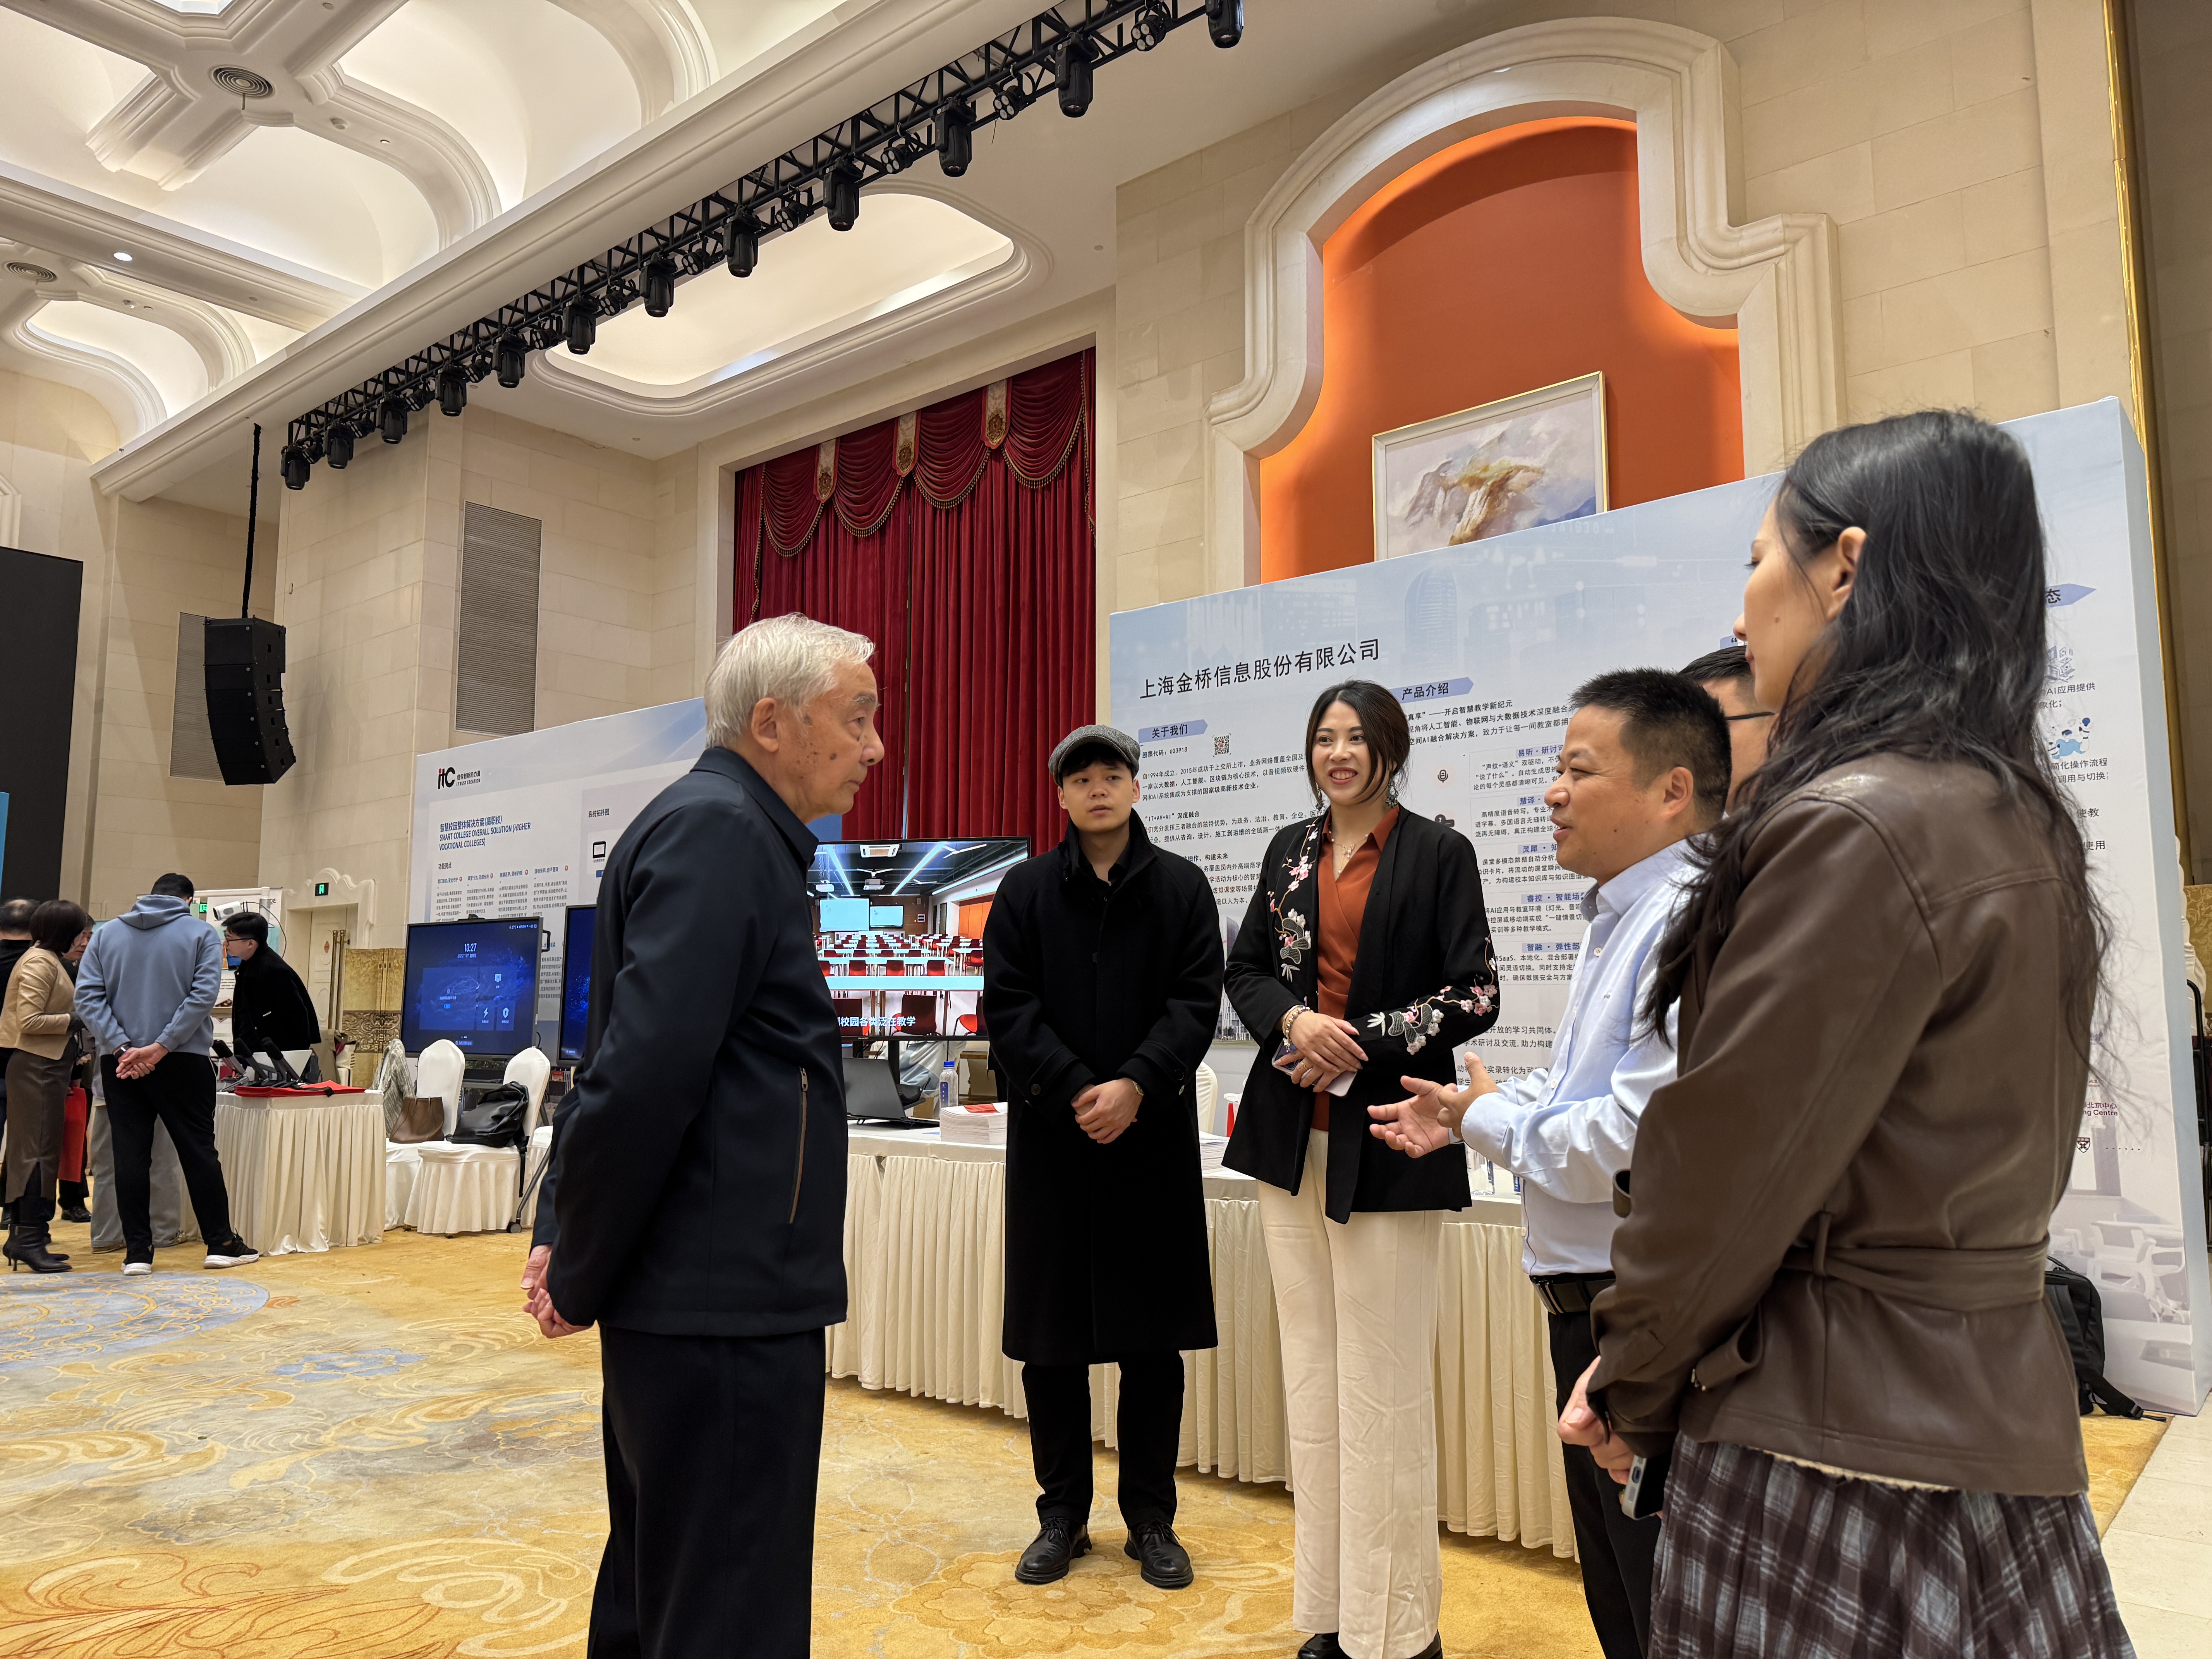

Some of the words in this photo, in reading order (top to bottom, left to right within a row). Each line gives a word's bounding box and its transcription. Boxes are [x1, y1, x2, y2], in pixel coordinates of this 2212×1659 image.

[1140, 638, 1379, 699] 上海金桥信息股份有限公司
[1402, 682, 1449, 701] 产品介绍
[2047, 682, 2095, 695] AI应用提供
[1152, 723, 1188, 739] 关于我们
[1410, 717, 1573, 746] 空间AI融合解决方案，致力于让每一间教室都拥
[1142, 747, 1188, 758] 股票代码：603918
[1142, 765, 1307, 790] 一家以大数据、人工智能、区块链为核心技术，以音视频软硬件
[1145, 810, 1322, 833] 们充分发挥三者融合的独特优势，为政务、法治、教育、企业、医
[440, 833, 452, 841] SMART
[453, 830, 471, 839] COLLEGE
[472, 828, 489, 837] OVERALL
[490, 825, 512, 835] SOLUTION
[513, 822, 531, 833] (HIGHER
[1149, 825, 1286, 843] 行业，提供从咨询、设计、施工到运维的全链路一体
[439, 841, 463, 850] VOCATIONAL
[464, 838, 486, 848] COLLEGES)
[2084, 840, 2105, 850] 使用
[1183, 853, 1228, 862] 细作，构建未来
[1200, 862, 1263, 872] 务覆盖国内外高端商学
[1207, 873, 1261, 883] 学活动为核心的智慧
[464, 943, 477, 952] 10:27
[838, 1016, 916, 1027] 校园各类泛在教学
[1485, 1026, 1556, 1034] 开放的学习共同体。
